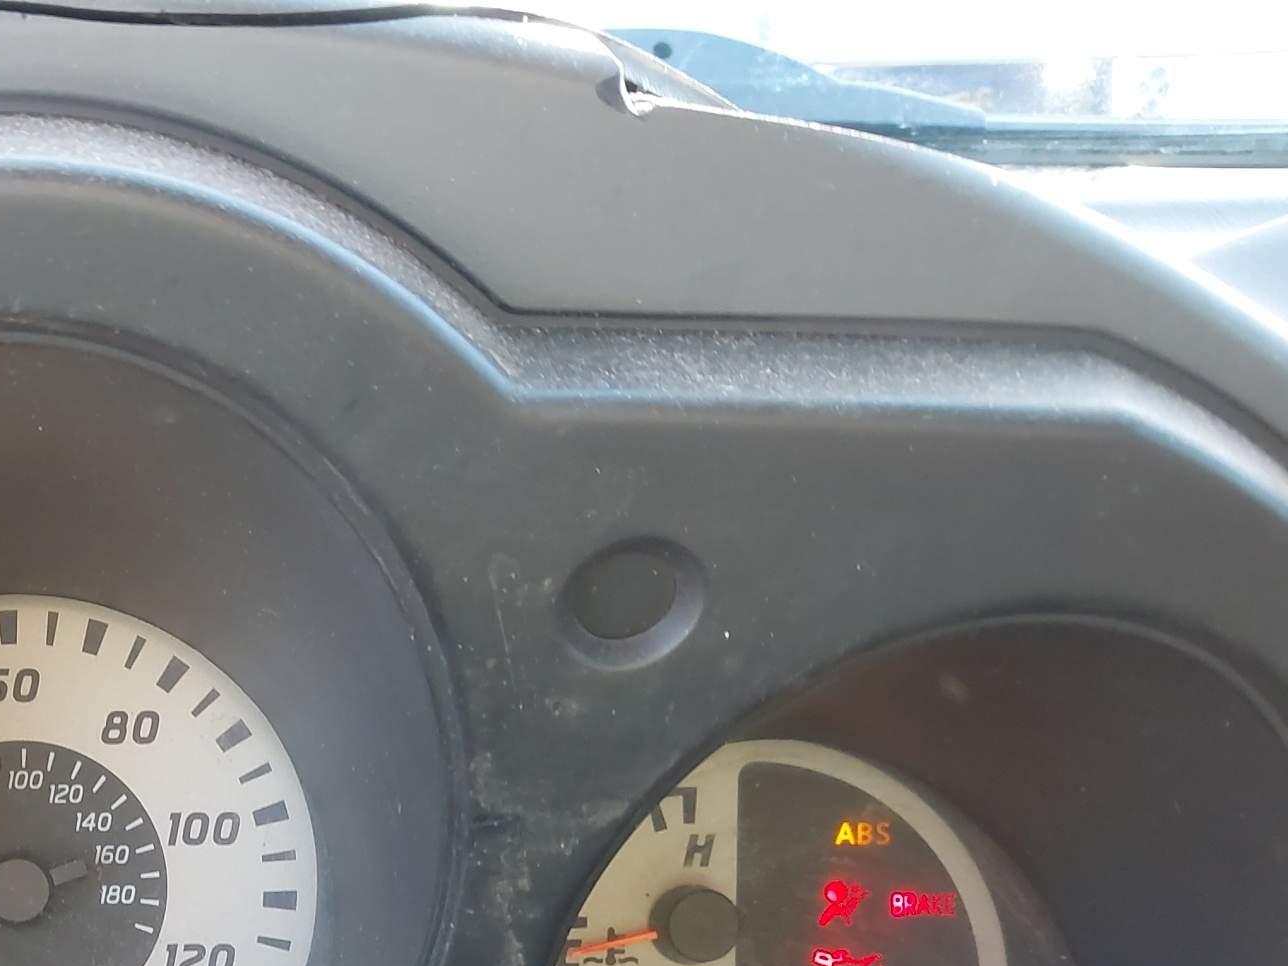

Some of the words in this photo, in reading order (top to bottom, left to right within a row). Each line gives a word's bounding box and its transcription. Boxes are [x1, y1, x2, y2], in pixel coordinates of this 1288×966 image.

[101, 710, 161, 745] 80
[8, 769, 44, 790] 100
[48, 783, 84, 804] 120
[75, 811, 112, 832] 140
[168, 811, 241, 846] 100
[833, 820, 892, 846] ABS
[95, 844, 130, 865] 160
[683, 834, 717, 867] H
[100, 884, 137, 905] 180
[890, 891, 956, 917] BRAKE
